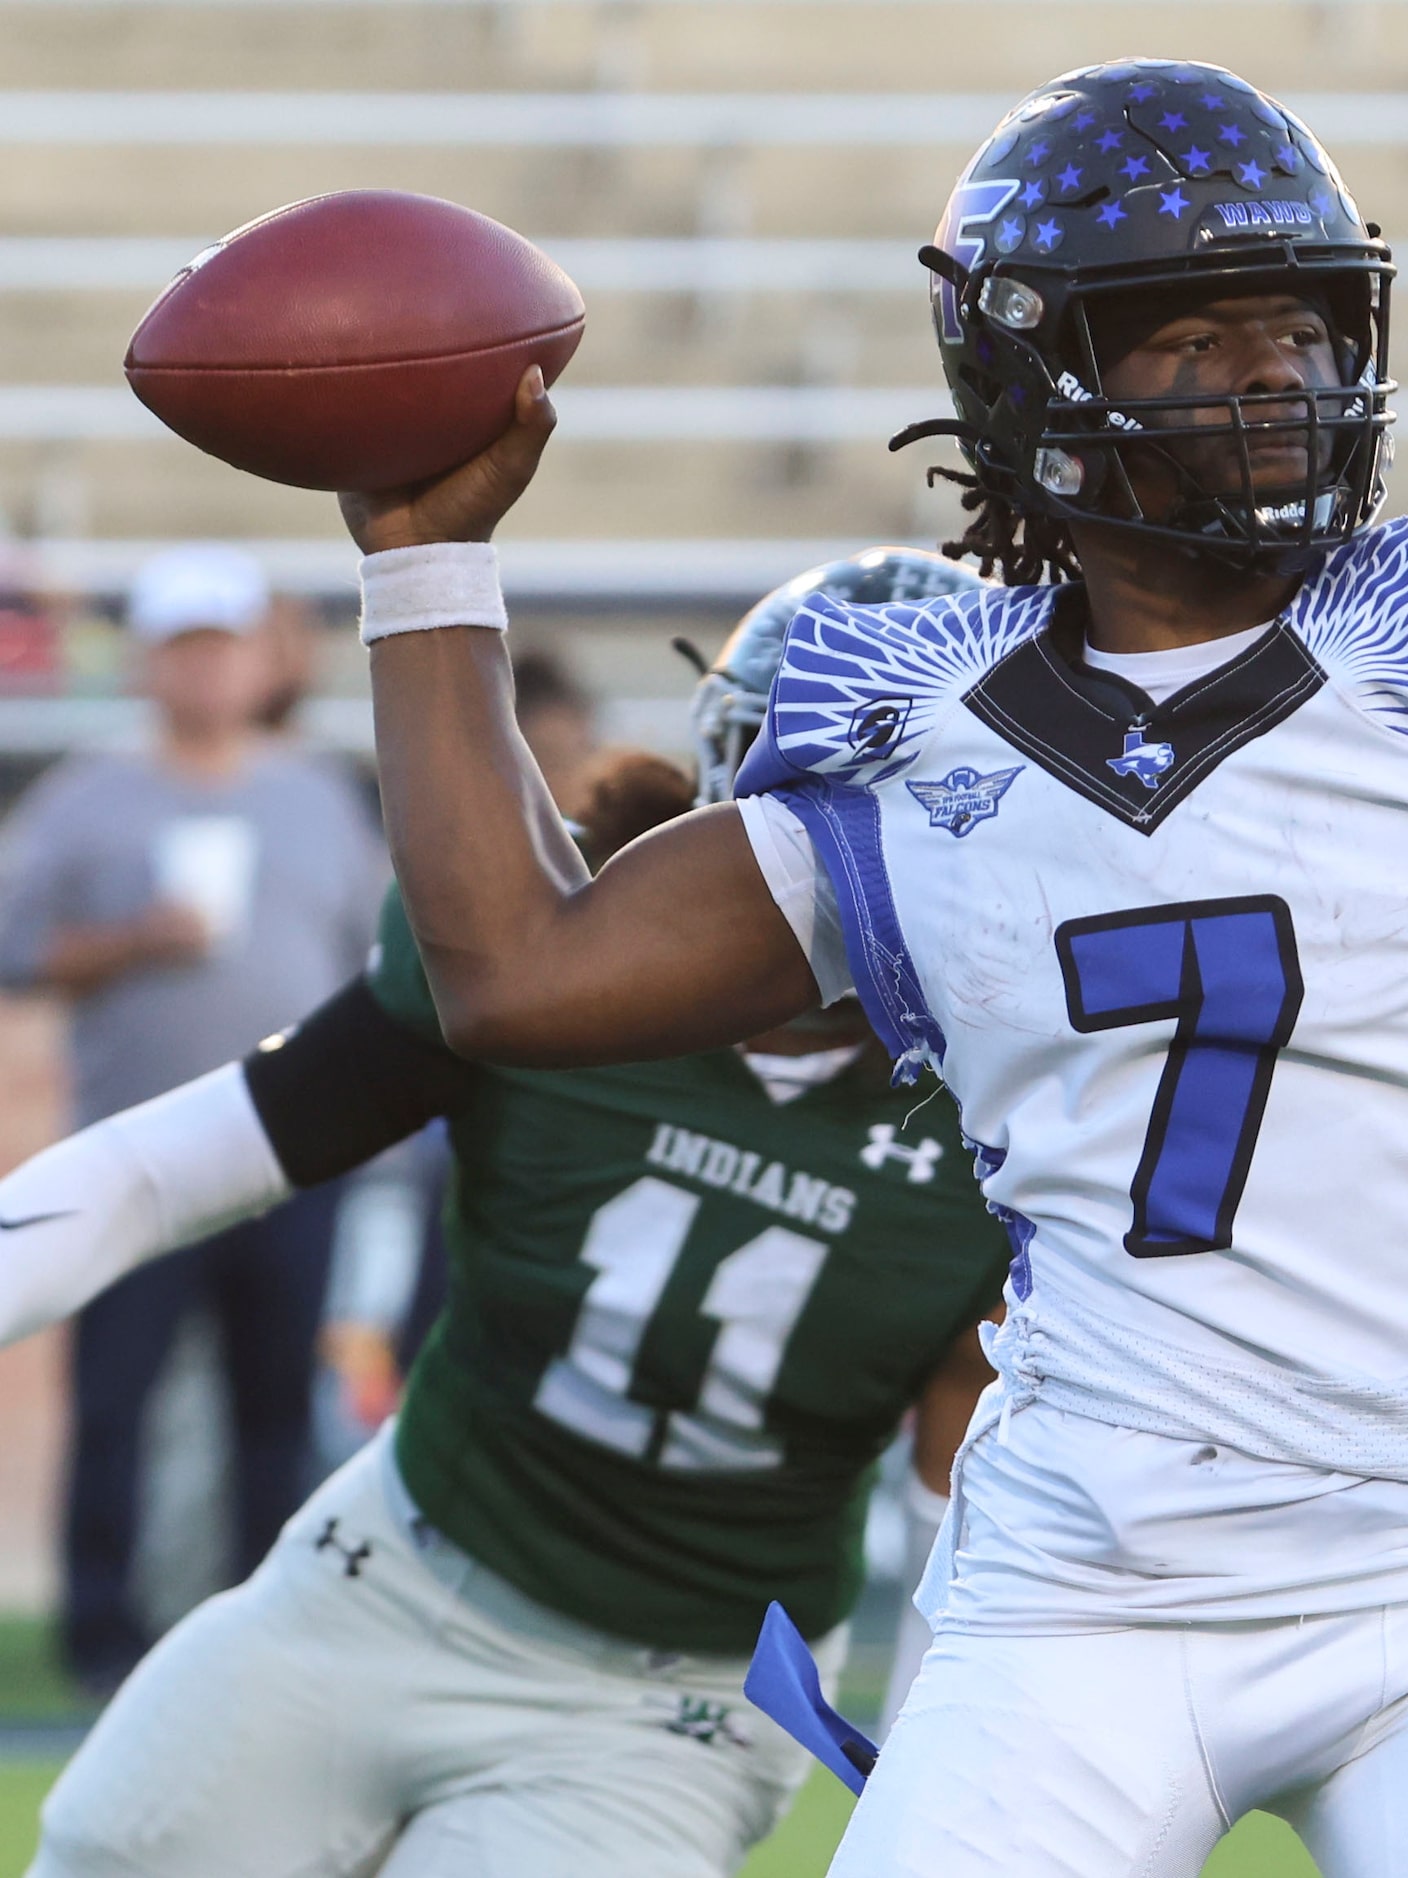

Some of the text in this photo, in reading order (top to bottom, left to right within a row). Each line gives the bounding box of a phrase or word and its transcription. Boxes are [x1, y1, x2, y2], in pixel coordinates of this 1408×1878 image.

[934, 799, 990, 818] FALCONS
[1054, 893, 1305, 1259] 7
[646, 1122, 858, 1235] INDIANS
[532, 1174, 831, 1469] 11
